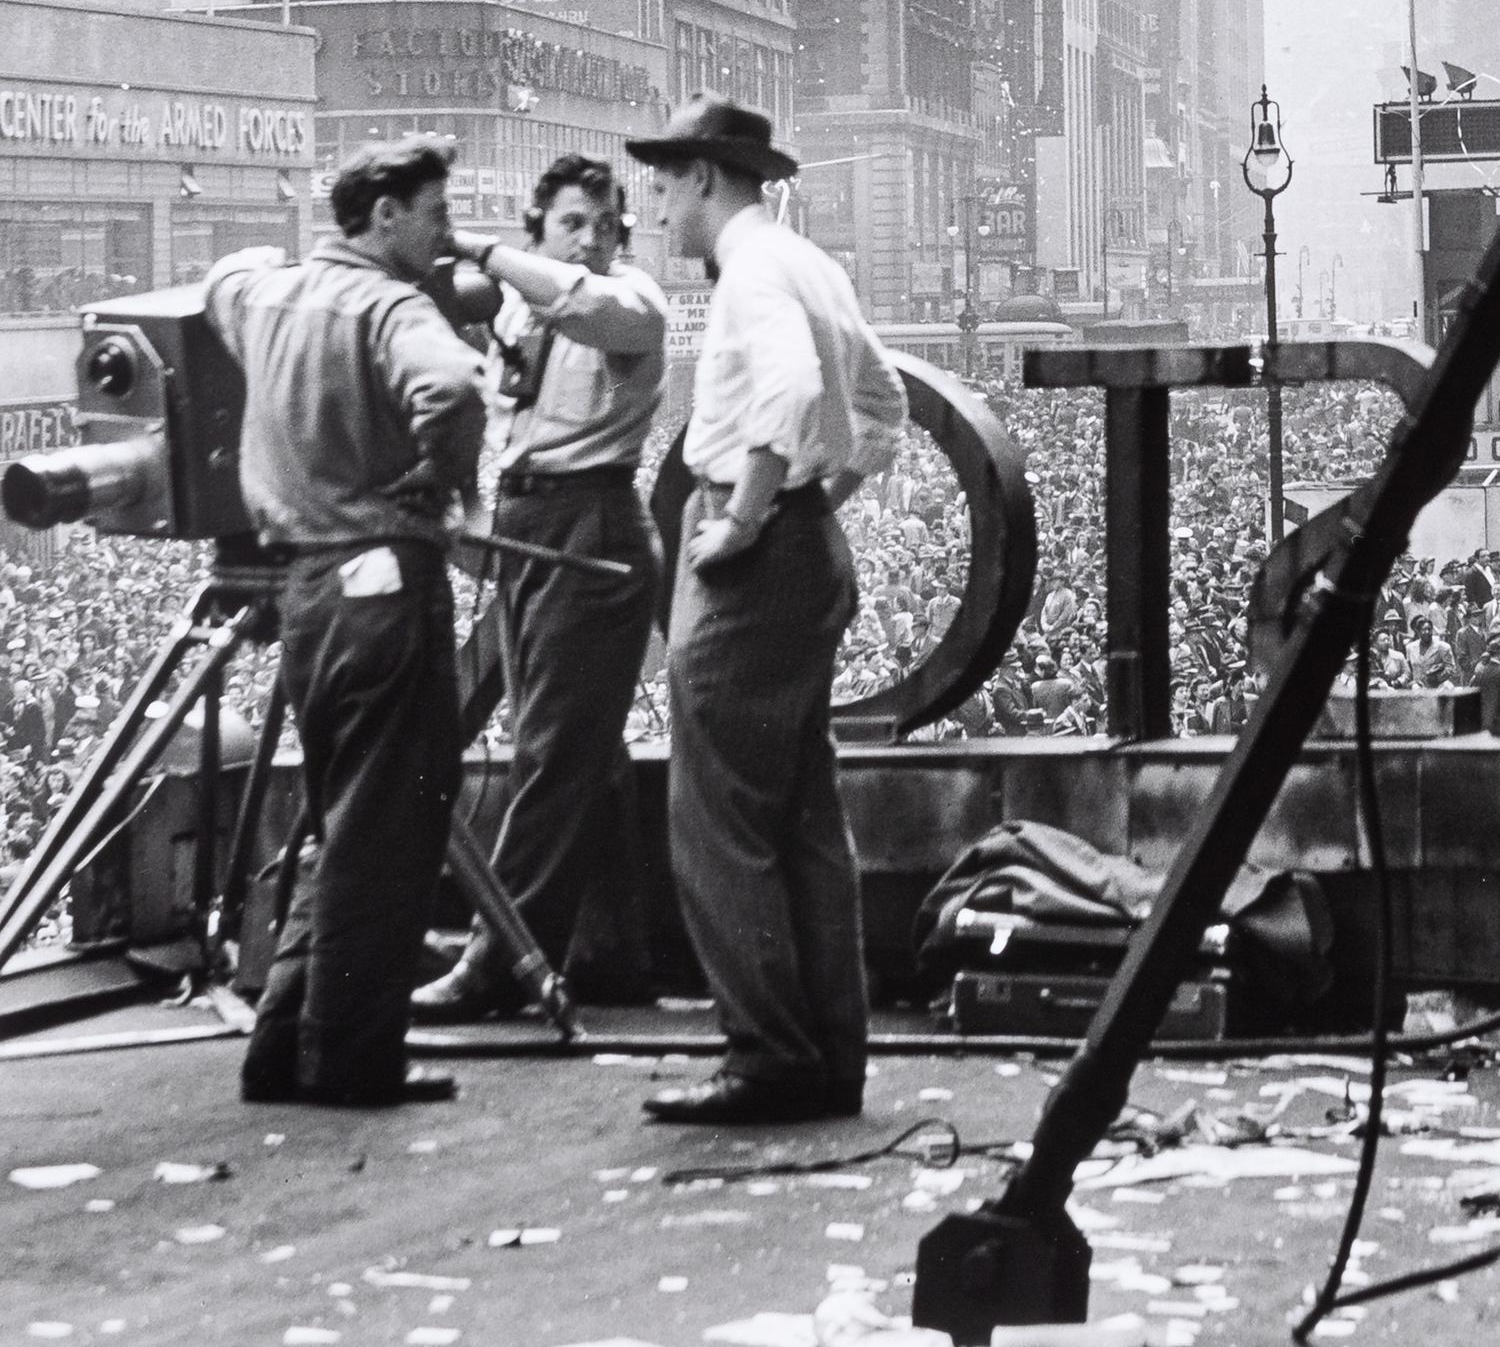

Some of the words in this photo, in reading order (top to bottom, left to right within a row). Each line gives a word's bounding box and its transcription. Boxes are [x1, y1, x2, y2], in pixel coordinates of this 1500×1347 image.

[1, 90, 78, 141] CENTER
[86, 96, 120, 142] for
[121, 104, 151, 143] the
[161, 101, 227, 148] ARMED
[237, 107, 307, 153] FORCES
